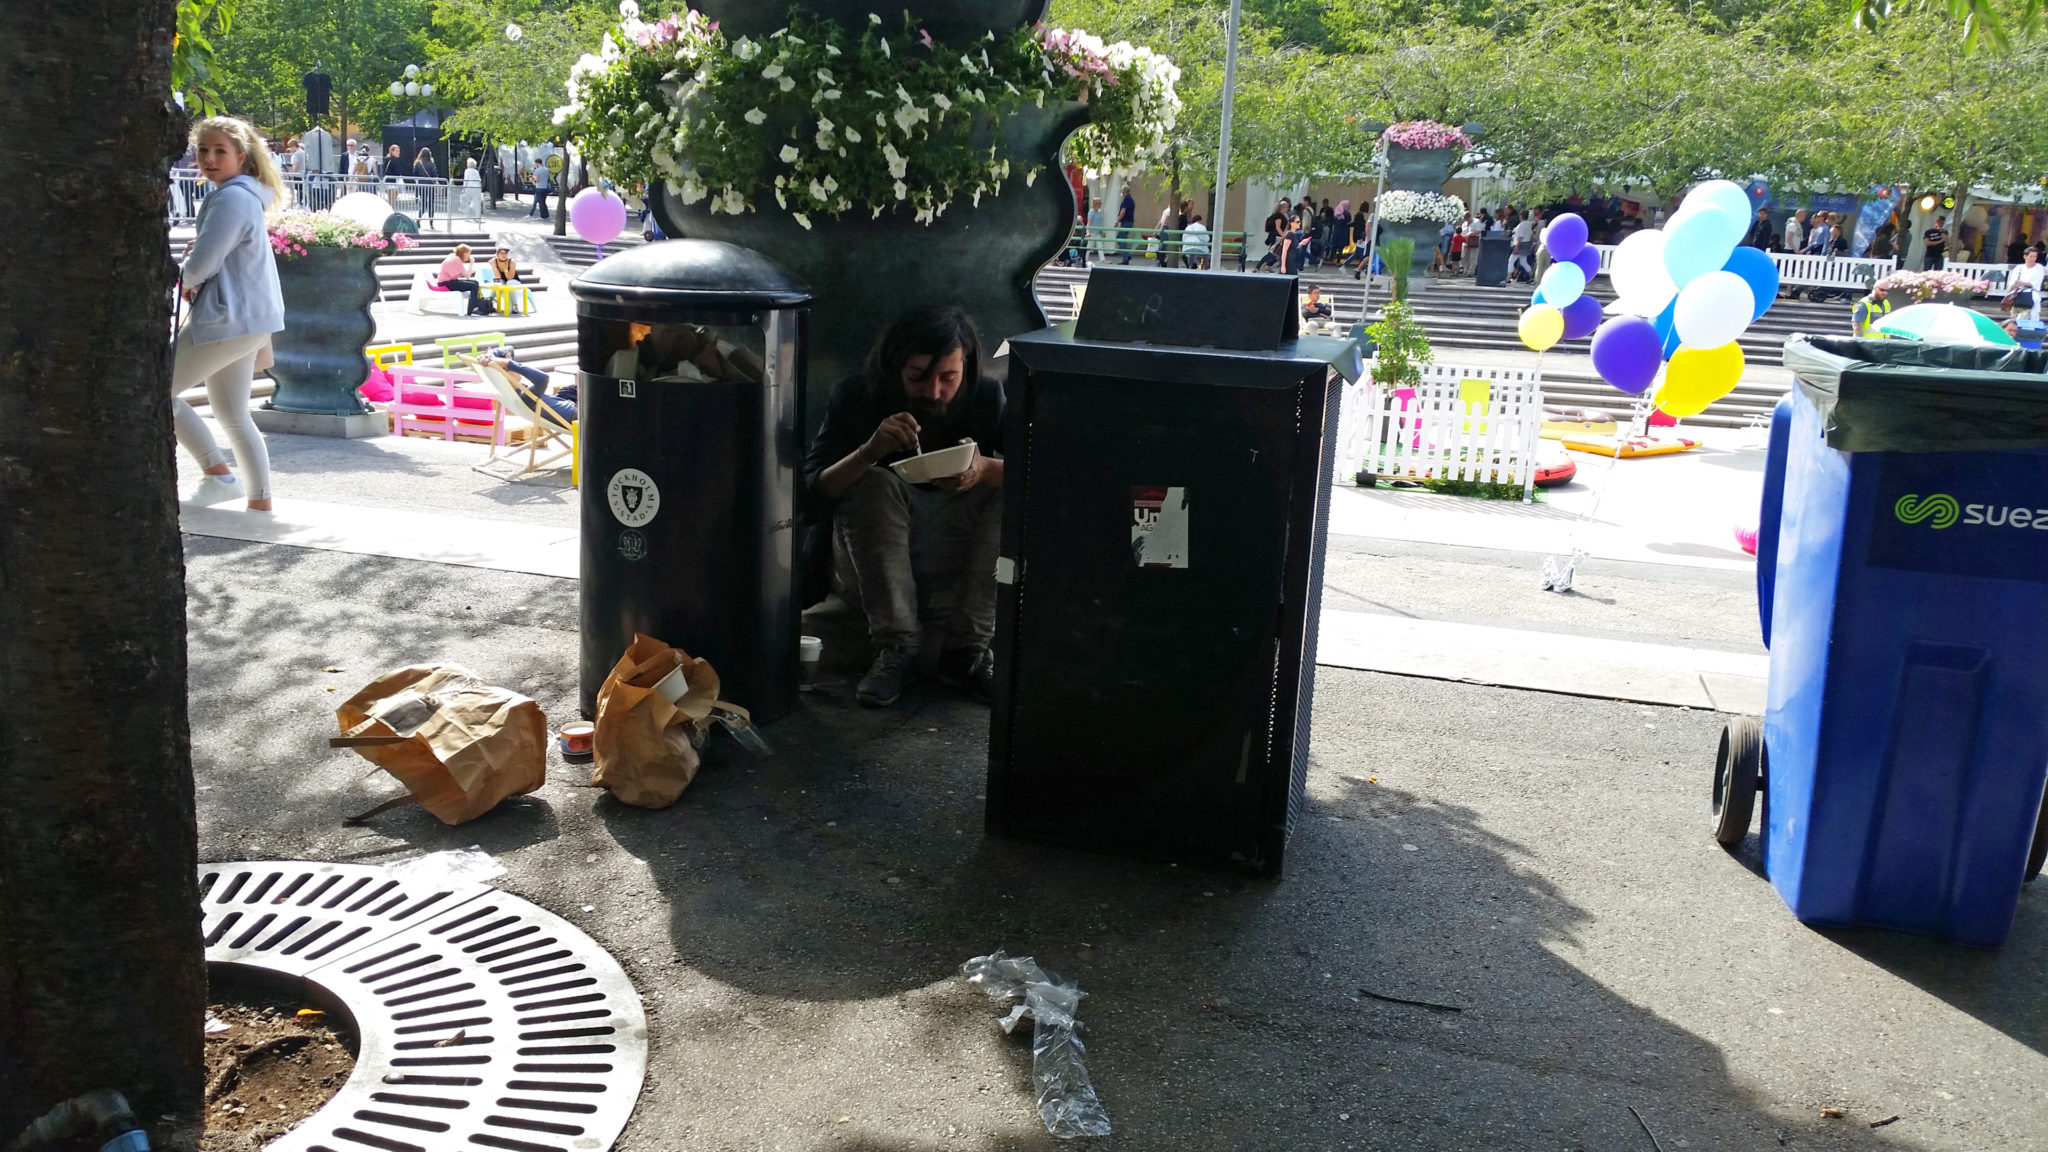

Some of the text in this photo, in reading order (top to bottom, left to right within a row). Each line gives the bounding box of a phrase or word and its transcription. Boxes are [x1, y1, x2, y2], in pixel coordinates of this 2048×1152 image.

[612, 474, 656, 511] STOCKHOLMS
[620, 510, 646, 522] STAD
[1963, 504, 2048, 531] suez
